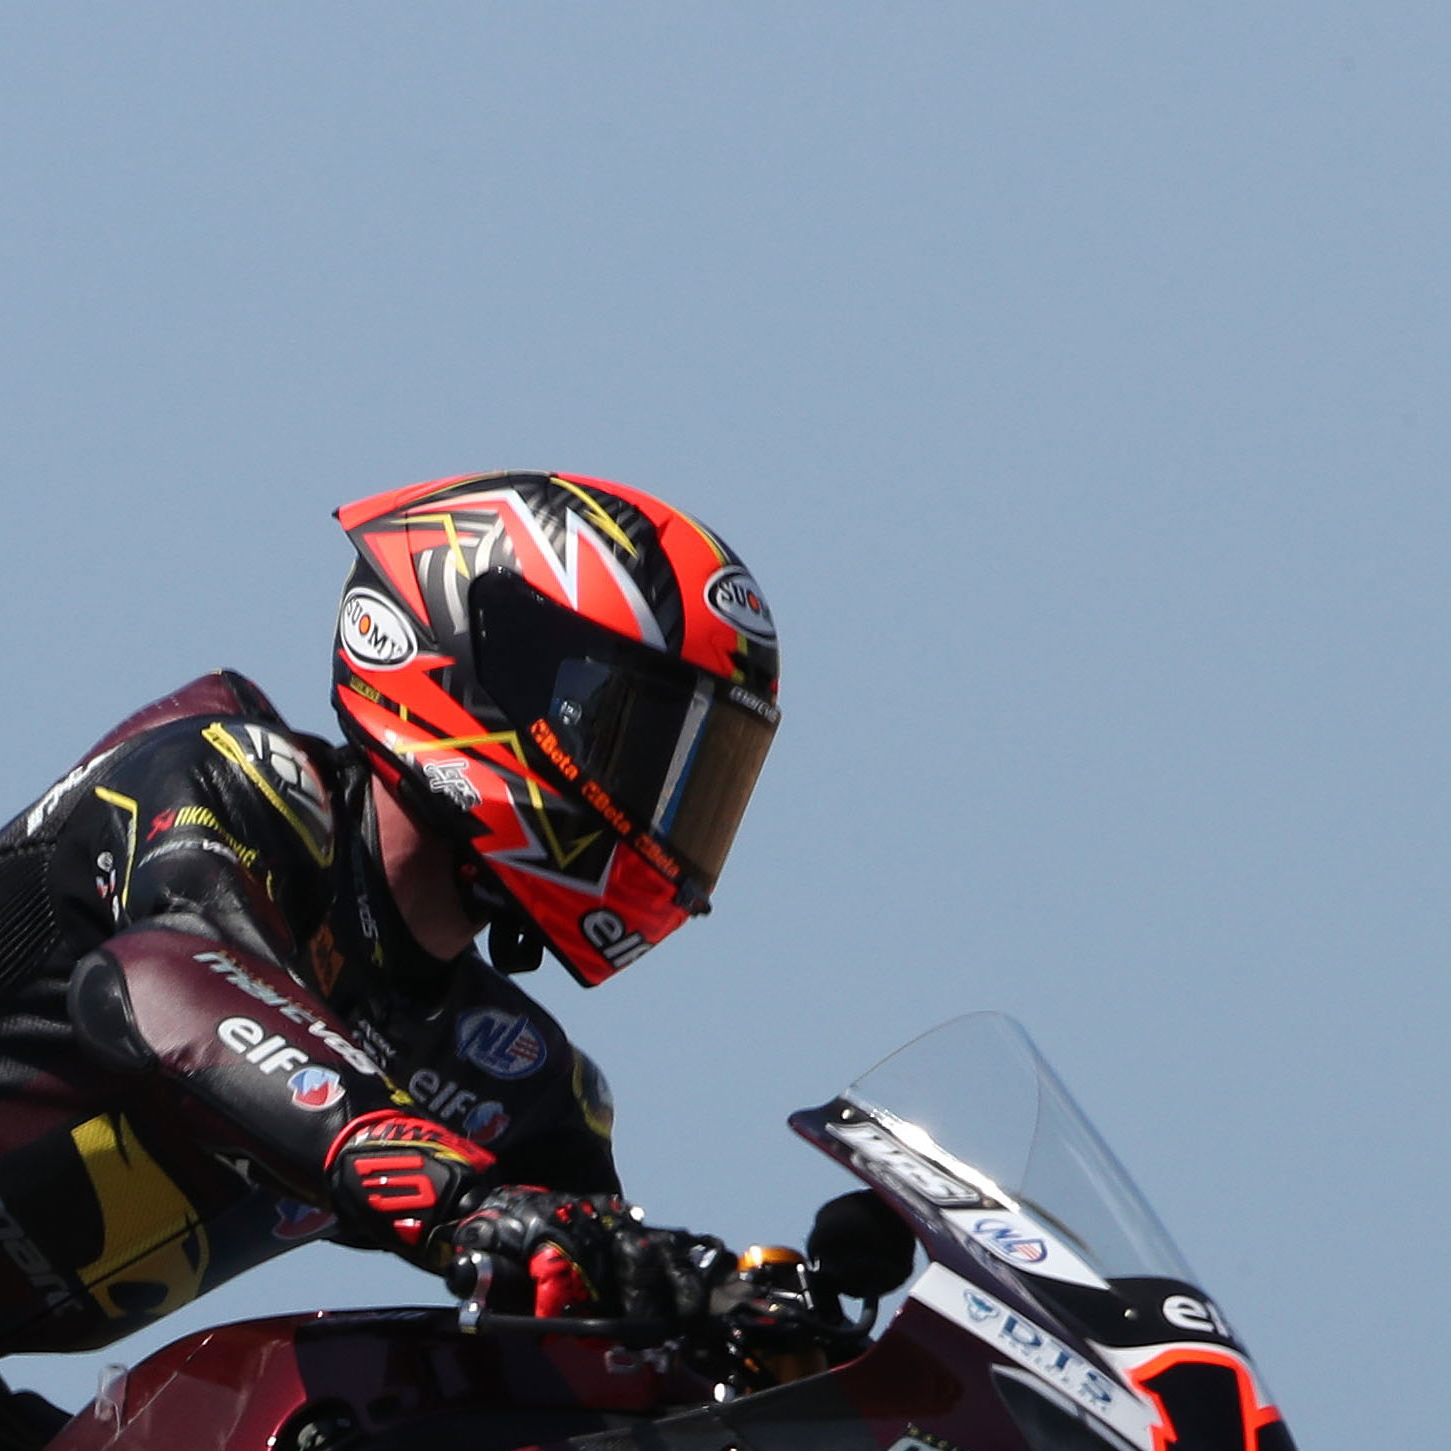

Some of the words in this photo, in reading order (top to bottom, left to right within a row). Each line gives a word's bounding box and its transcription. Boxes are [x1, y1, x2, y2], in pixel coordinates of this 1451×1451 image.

[345, 598, 397, 661] SUOMY
[217, 1017, 309, 1076] elf
[409, 1067, 477, 1119] elf
[1162, 1295, 1230, 1337] el
